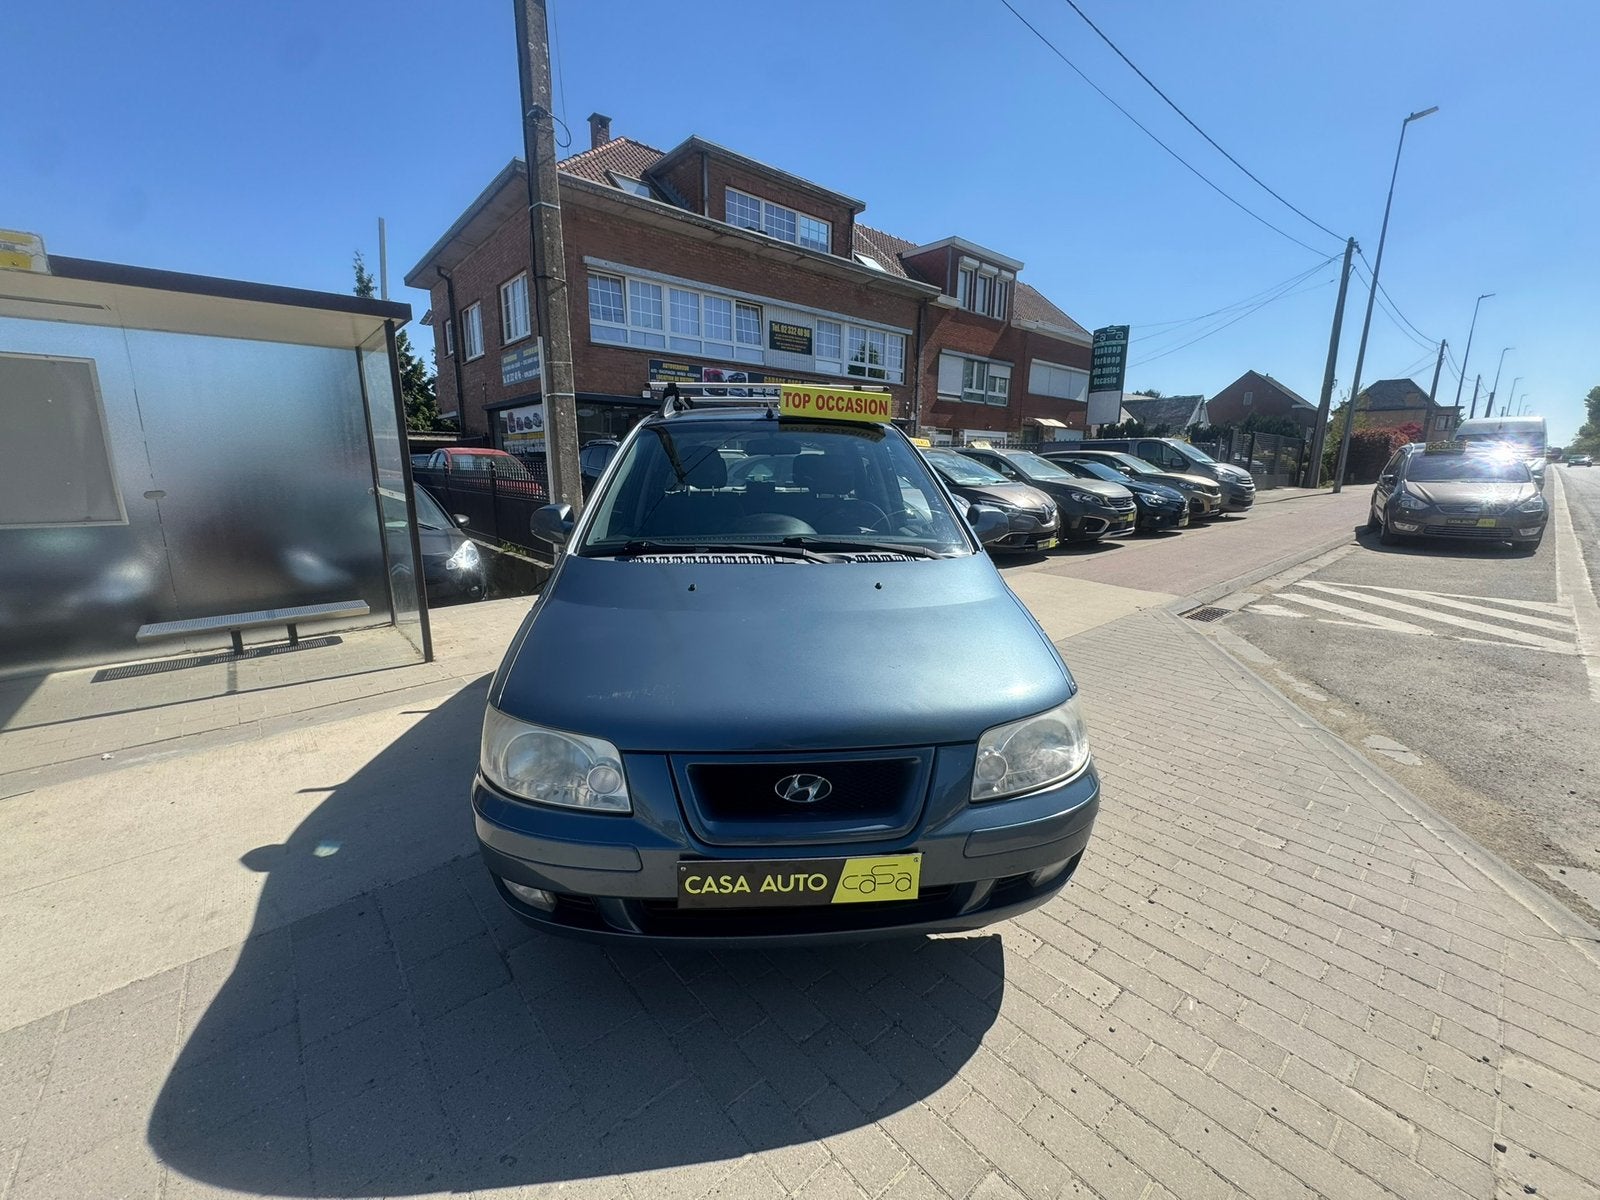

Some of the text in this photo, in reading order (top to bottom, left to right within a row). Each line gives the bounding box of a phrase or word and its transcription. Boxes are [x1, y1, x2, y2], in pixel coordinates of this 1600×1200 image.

[783, 391, 888, 416] TOP OCCASION
[684, 874, 751, 895] CASA
[760, 872, 828, 893] AUTO
